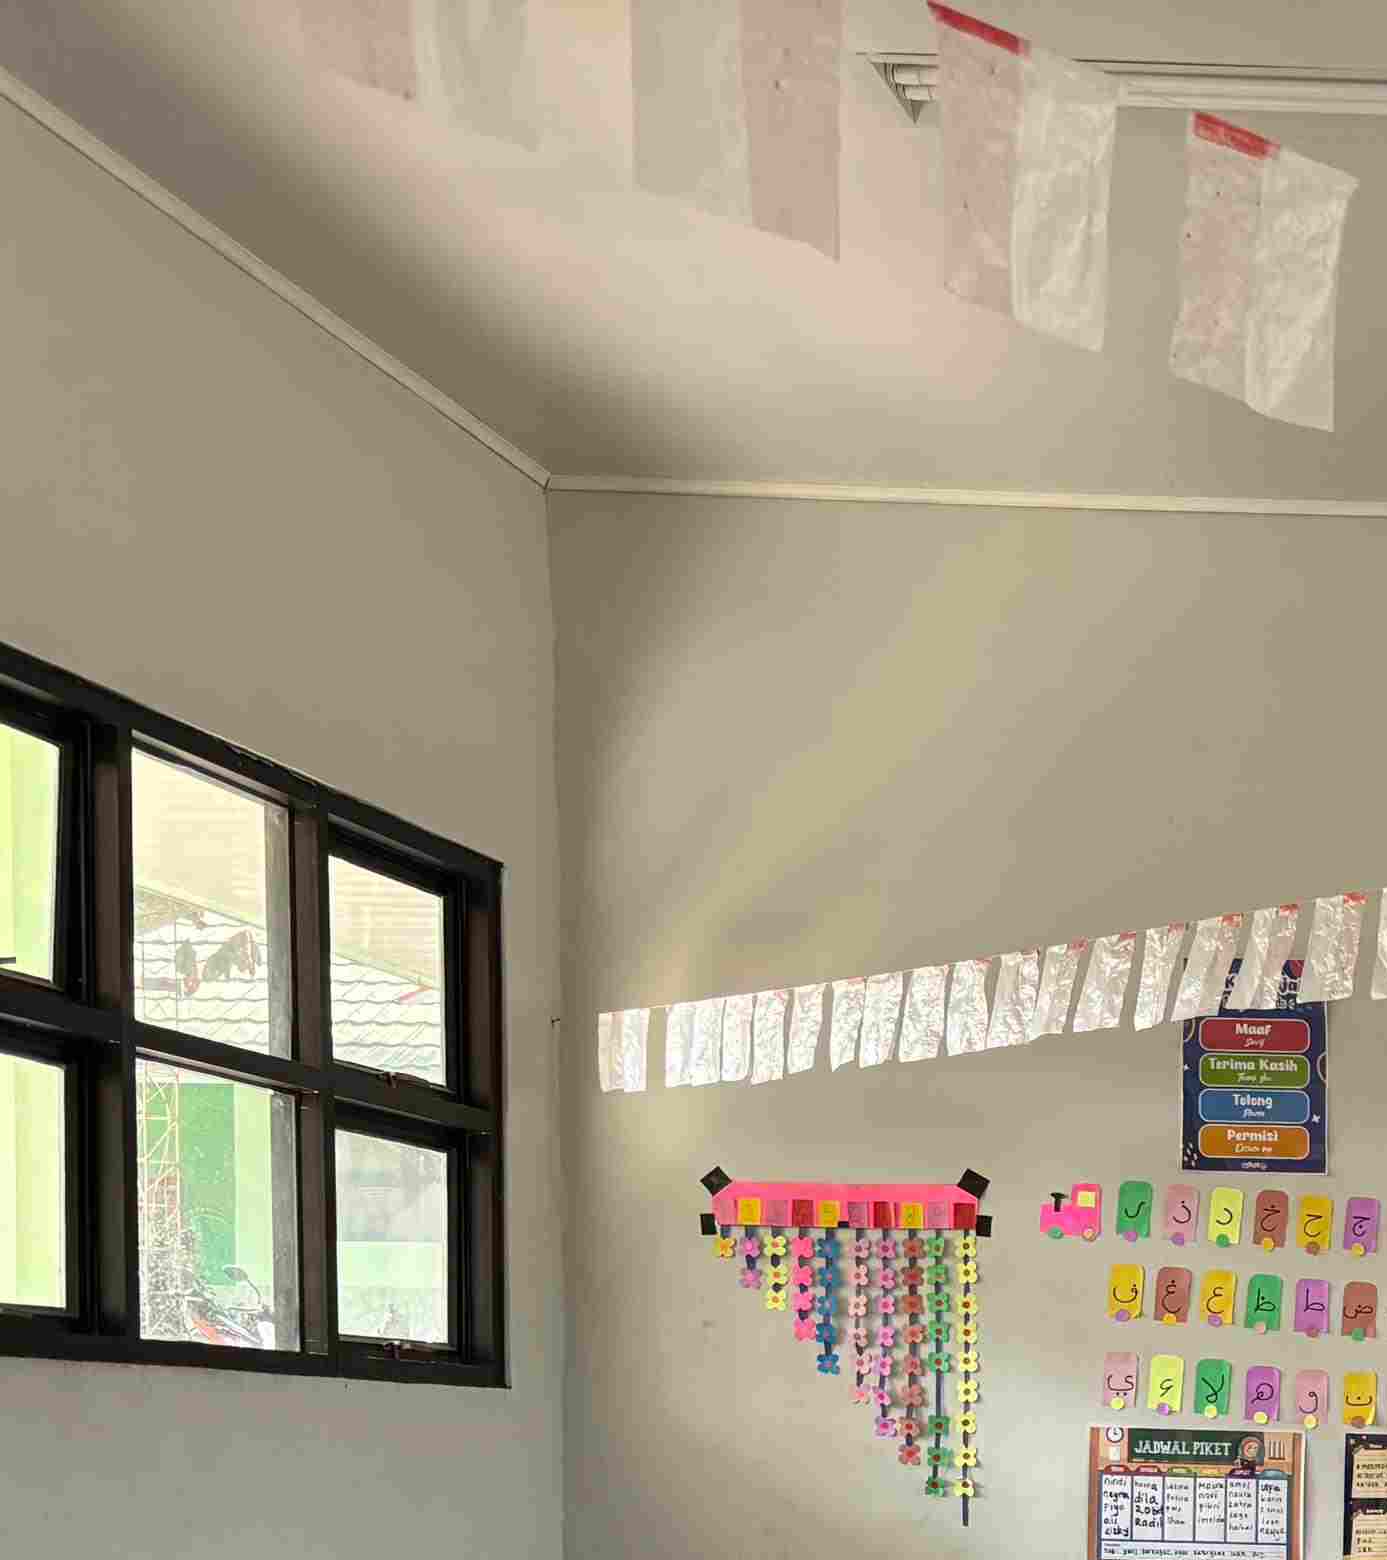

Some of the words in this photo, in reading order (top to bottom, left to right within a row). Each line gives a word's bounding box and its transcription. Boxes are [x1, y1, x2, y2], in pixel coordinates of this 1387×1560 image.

[1235, 1023, 1273, 1036] Maaf
[1208, 1057, 1256, 1072] Terima
[1257, 1059, 1298, 1072] Kasih
[1232, 1093, 1273, 1109] Tolong
[1226, 1129, 1280, 1142] Permisi
[1260, 1204, 1281, 1232] خ
[1351, 1215, 1371, 1237] ج
[1161, 1279, 1182, 1314] غ
[1206, 1286, 1225, 1314] ع
[1254, 1288, 1277, 1313] ظ
[1303, 1288, 1326, 1313] ط
[1343, 1302, 1374, 1319] ض
[1299, 1391, 1319, 1414] و
[1134, 1440, 1190, 1455] JADWAL
[1192, 1441, 1232, 1457] PIKET
